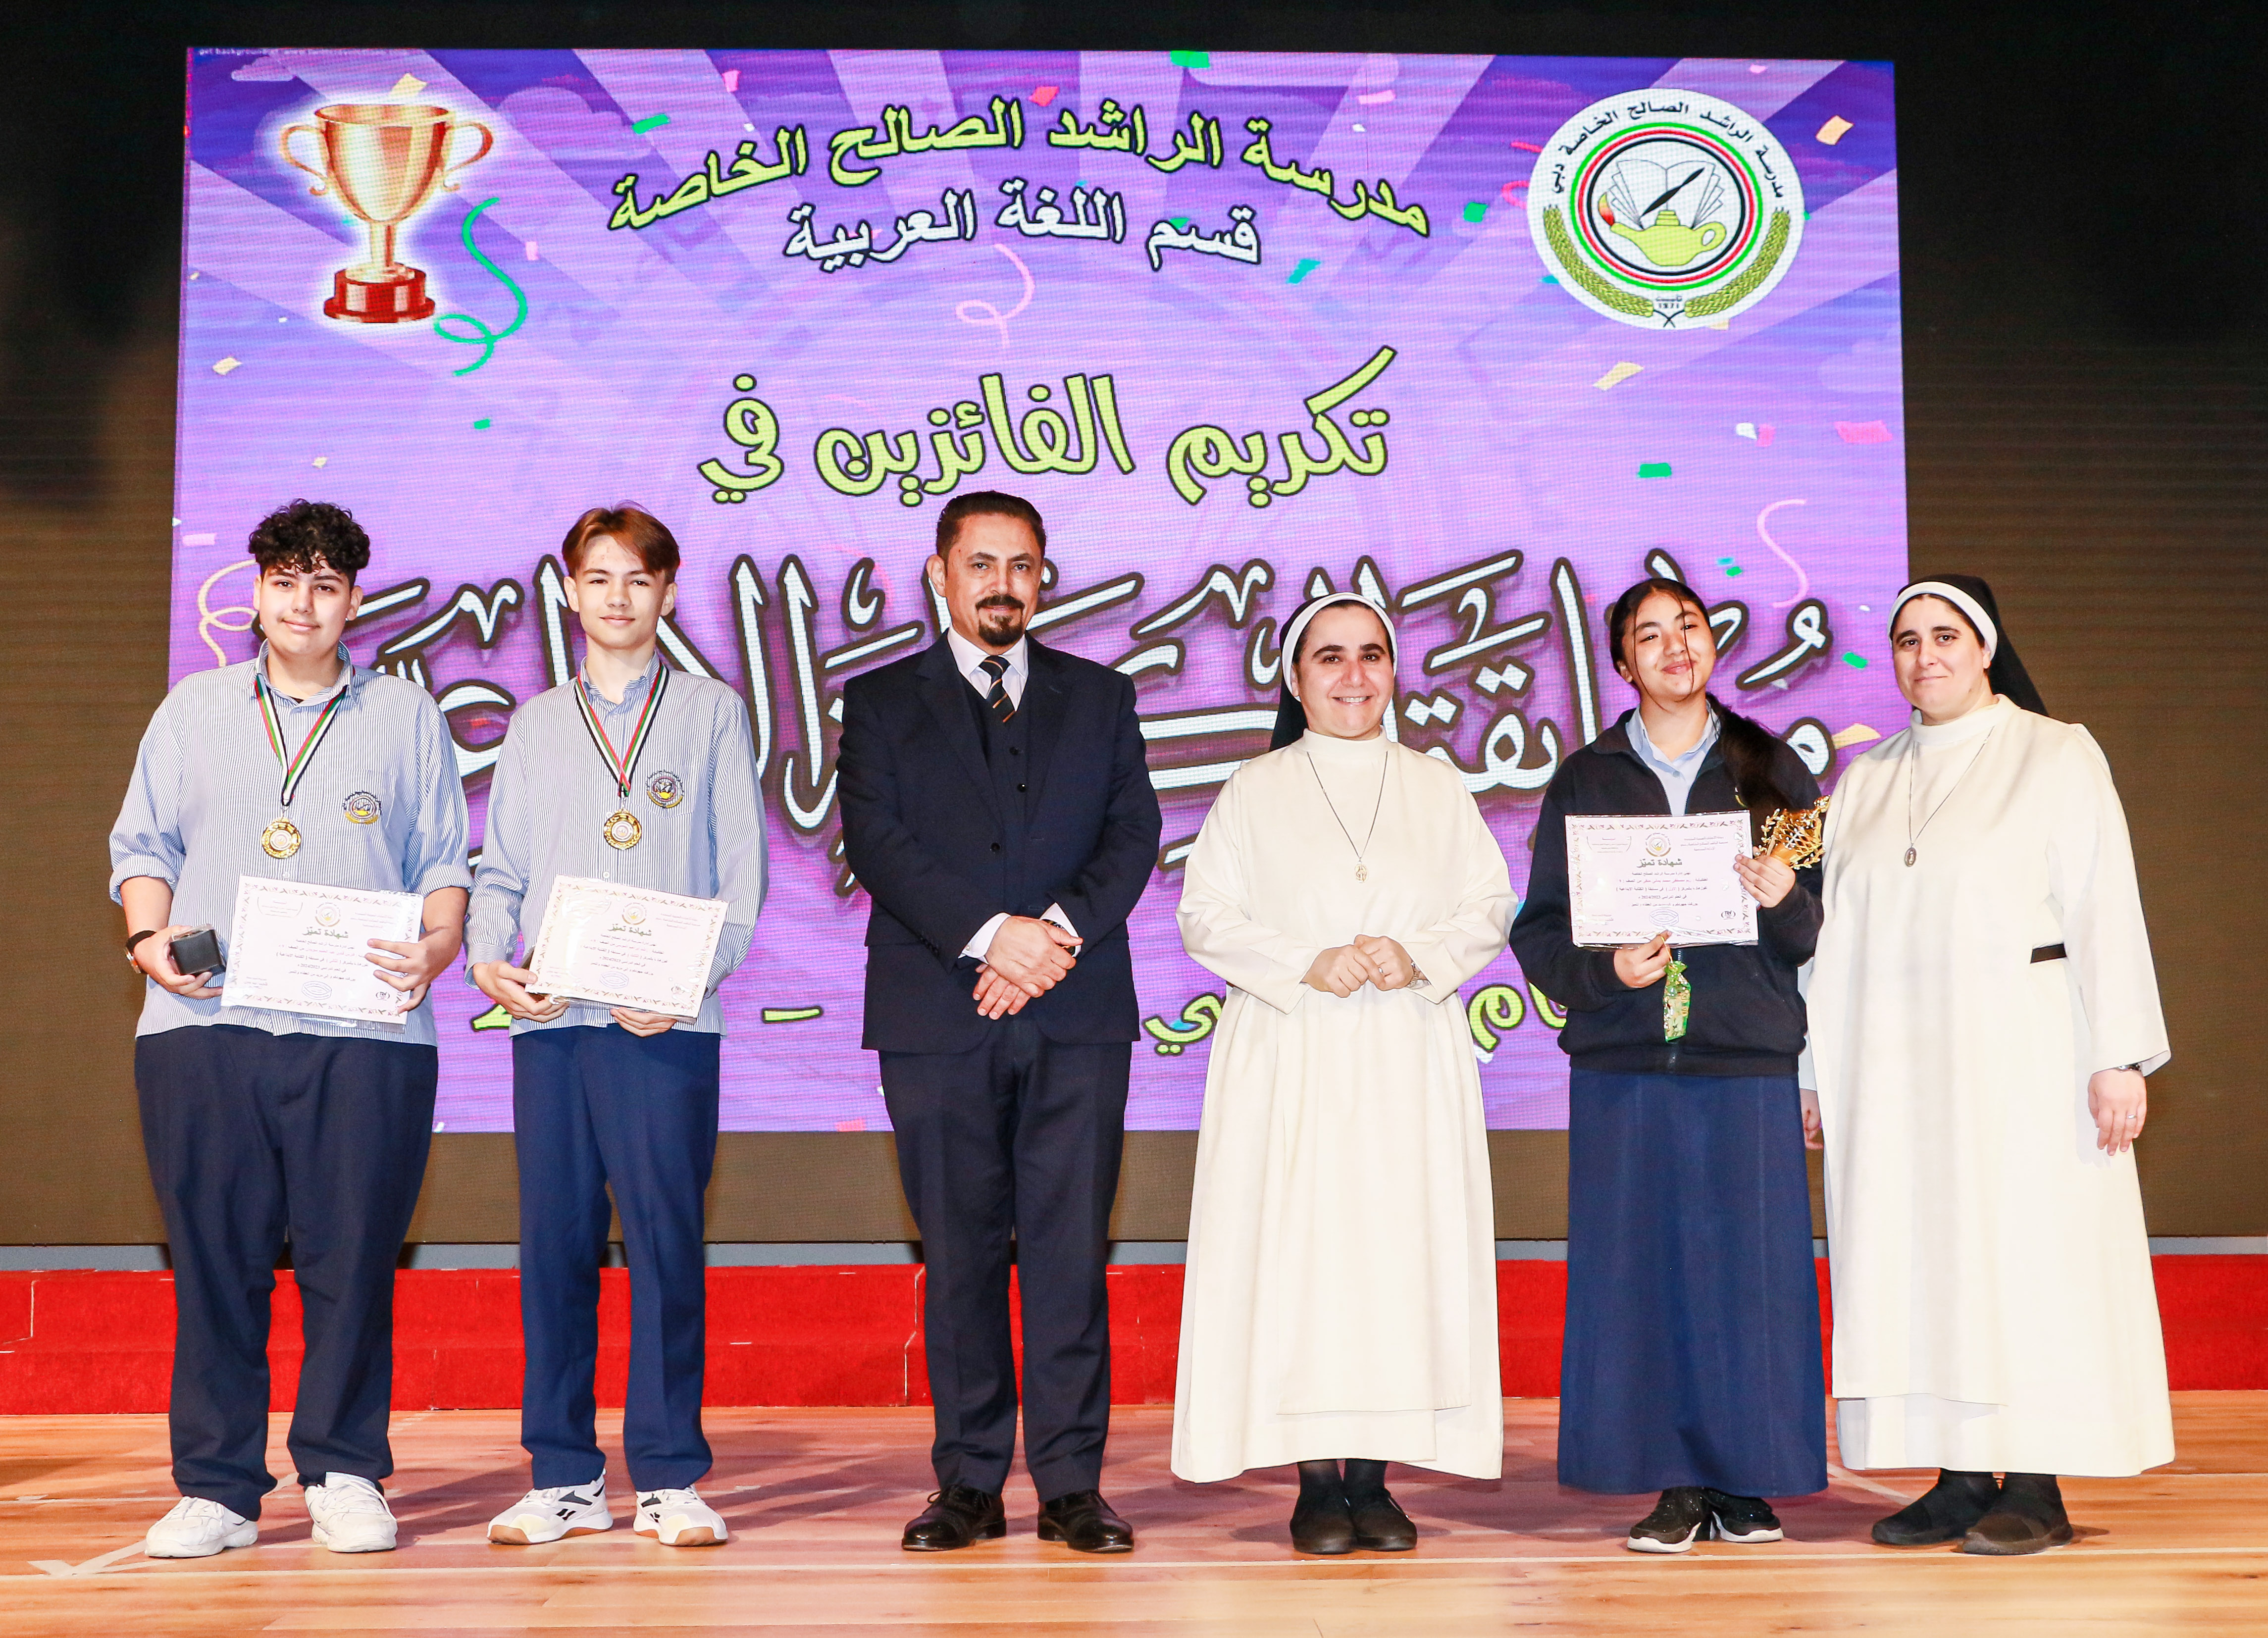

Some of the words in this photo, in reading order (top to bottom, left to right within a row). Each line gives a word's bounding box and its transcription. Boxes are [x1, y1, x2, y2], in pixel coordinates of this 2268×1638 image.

[829, 96, 1025, 186] الصالح
[1047, 98, 1224, 173] الراشد
[1558, 109, 1619, 156] الخاصة
[1627, 101, 1689, 120] الصالح
[1699, 111, 1754, 144] الراشد
[608, 124, 807, 231] الخاصة
[1241, 116, 1431, 237] مدرسة
[1755, 144, 1784, 198] مدرسة
[784, 187, 978, 273] العربية
[995, 177, 1127, 243] اللغة
[1146, 205, 1262, 272] قسم
[697, 373, 785, 503] في
[814, 372, 1136, 508] الفائزين
[1166, 345, 1397, 508] تكريم
[1658, 858, 1682, 867] شهادة
